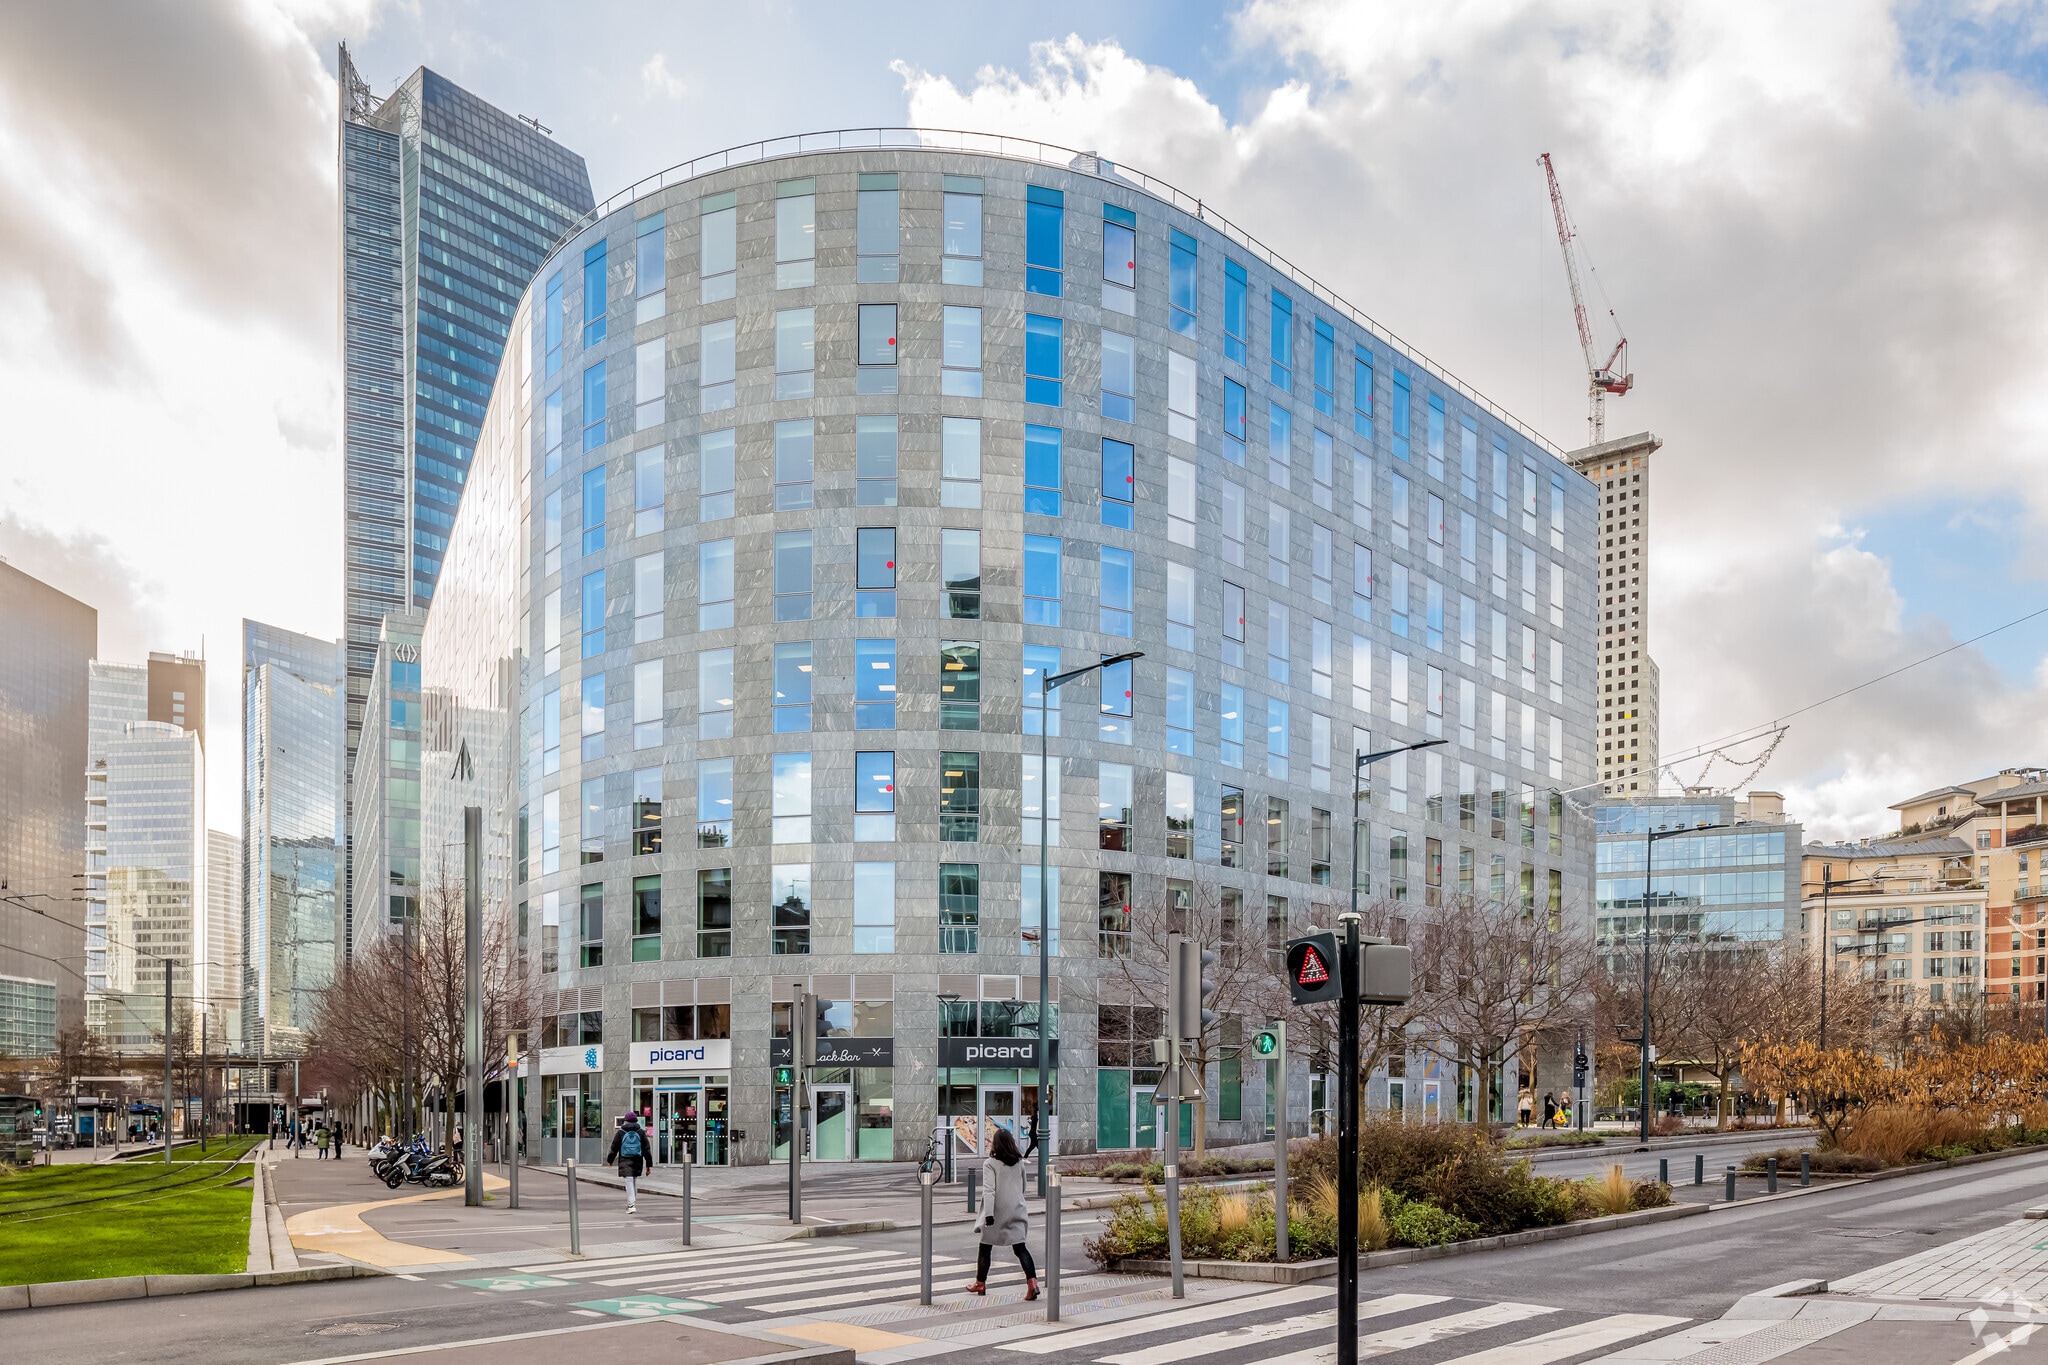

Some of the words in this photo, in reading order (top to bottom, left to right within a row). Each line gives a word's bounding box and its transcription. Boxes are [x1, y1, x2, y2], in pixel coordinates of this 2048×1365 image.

[650, 1046, 704, 1064] picard
[802, 1050, 839, 1062] ack
[840, 1049, 861, 1062] Bar
[966, 1044, 1032, 1061] picard
